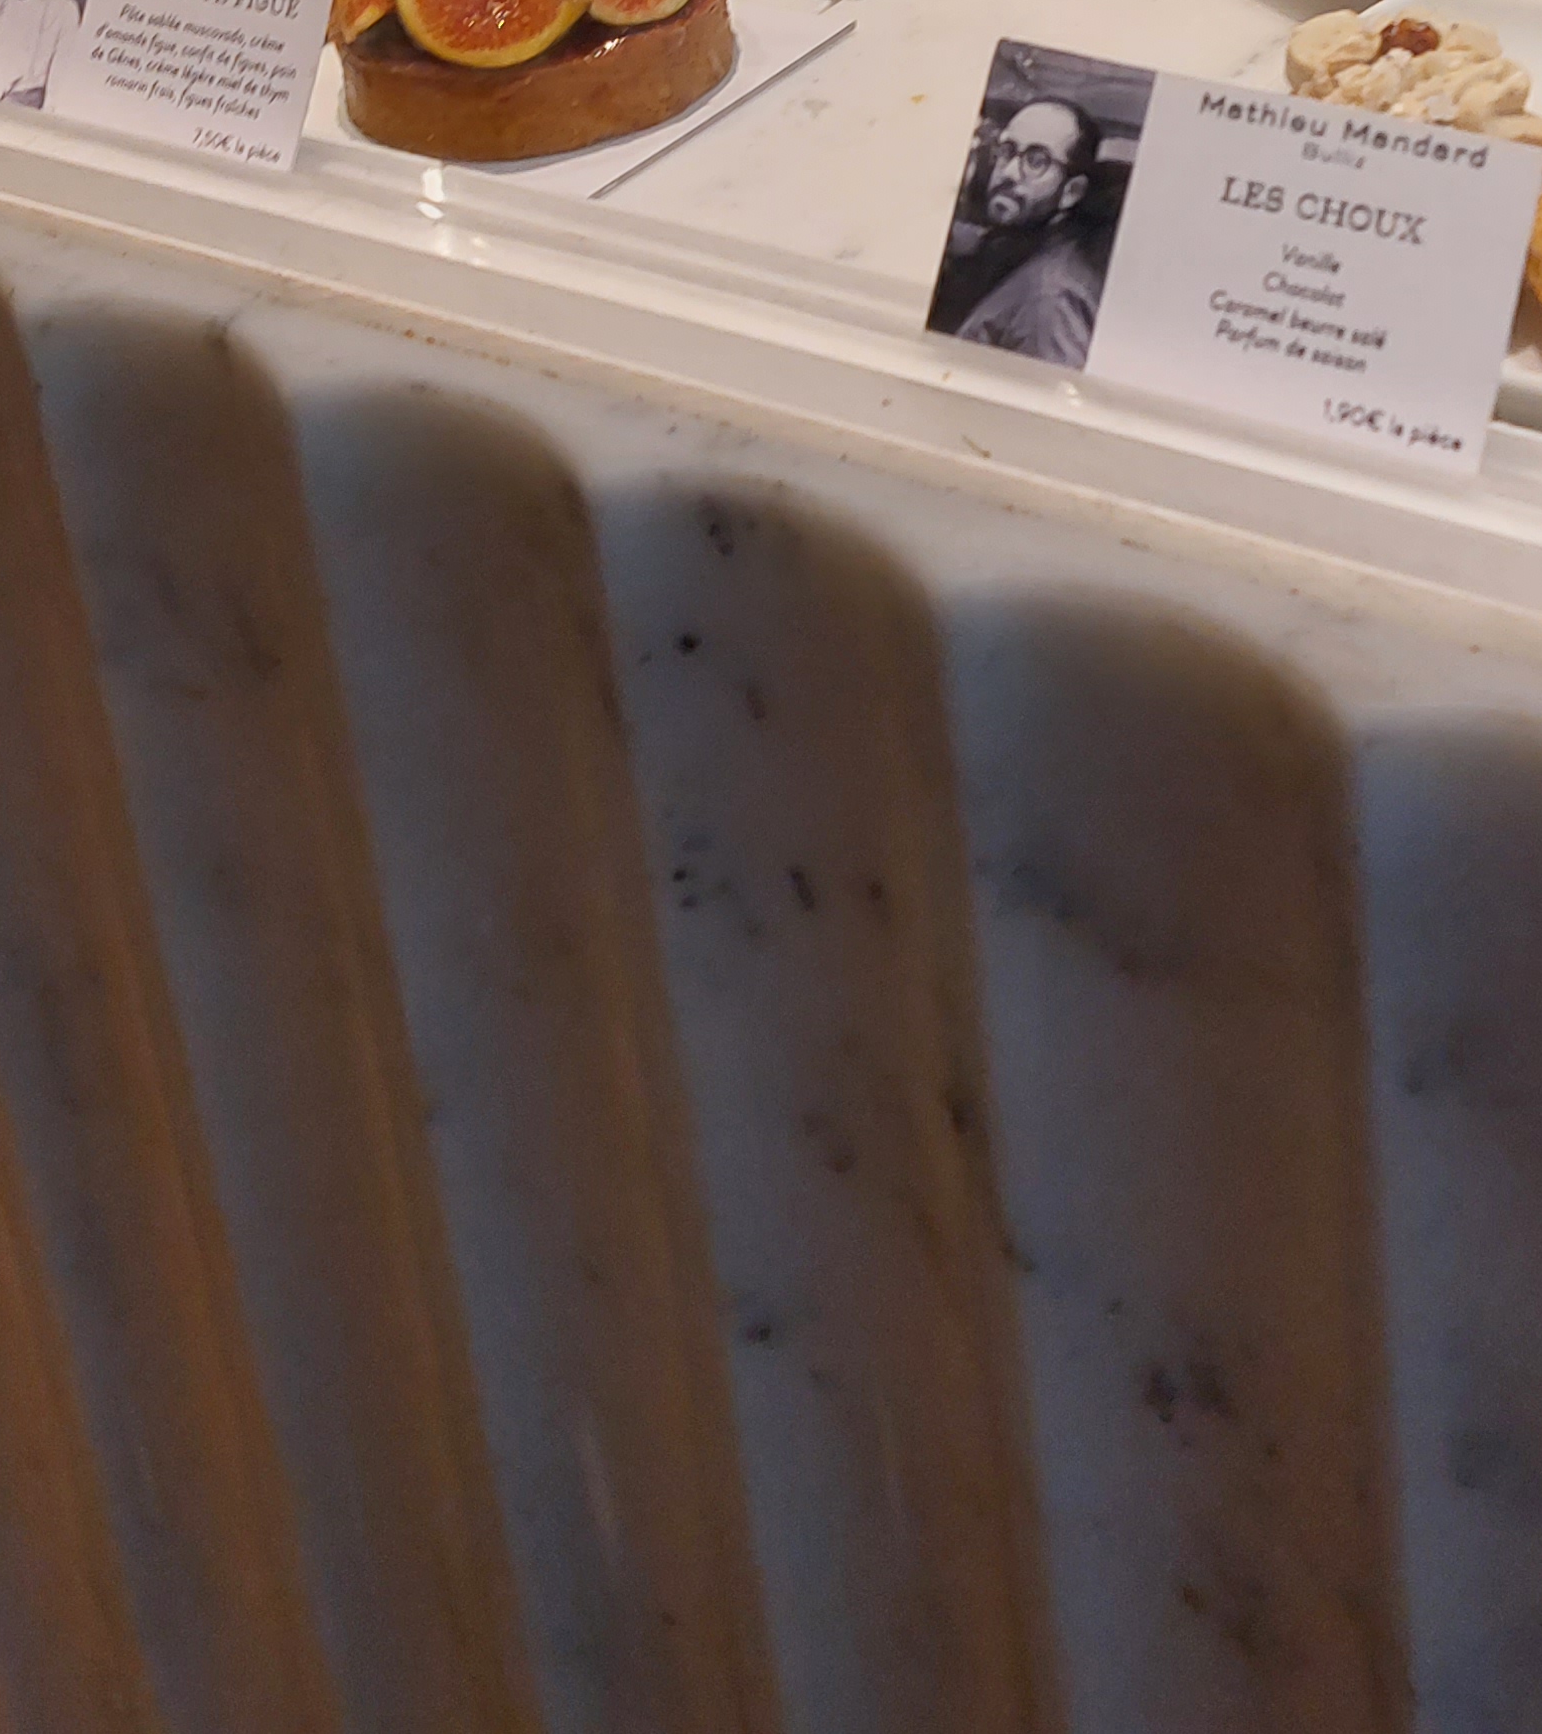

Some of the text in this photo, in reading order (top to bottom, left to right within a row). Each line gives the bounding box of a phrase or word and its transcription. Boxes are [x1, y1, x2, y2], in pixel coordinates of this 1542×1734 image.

[217, 49, 231, 66] de
[250, 36, 285, 52] crème
[91, 46, 105, 60] de
[146, 61, 180, 77] crème
[216, 76, 245, 90] miel
[243, 79, 258, 95] de
[104, 74, 148, 92] romarin
[234, 137, 246, 155] la
[1199, 92, 1488, 169] Mathieu Mandard
[1219, 176, 1427, 246] LES CHOUX
[1283, 245, 1342, 275] Vanille
[1262, 270, 1346, 309] Chocolat
[1209, 288, 1386, 350] Caramel beurre salé
[1214, 317, 1368, 372] Parfum de saison
[1390, 419, 1405, 438] la
[1409, 428, 1463, 452] pièce
